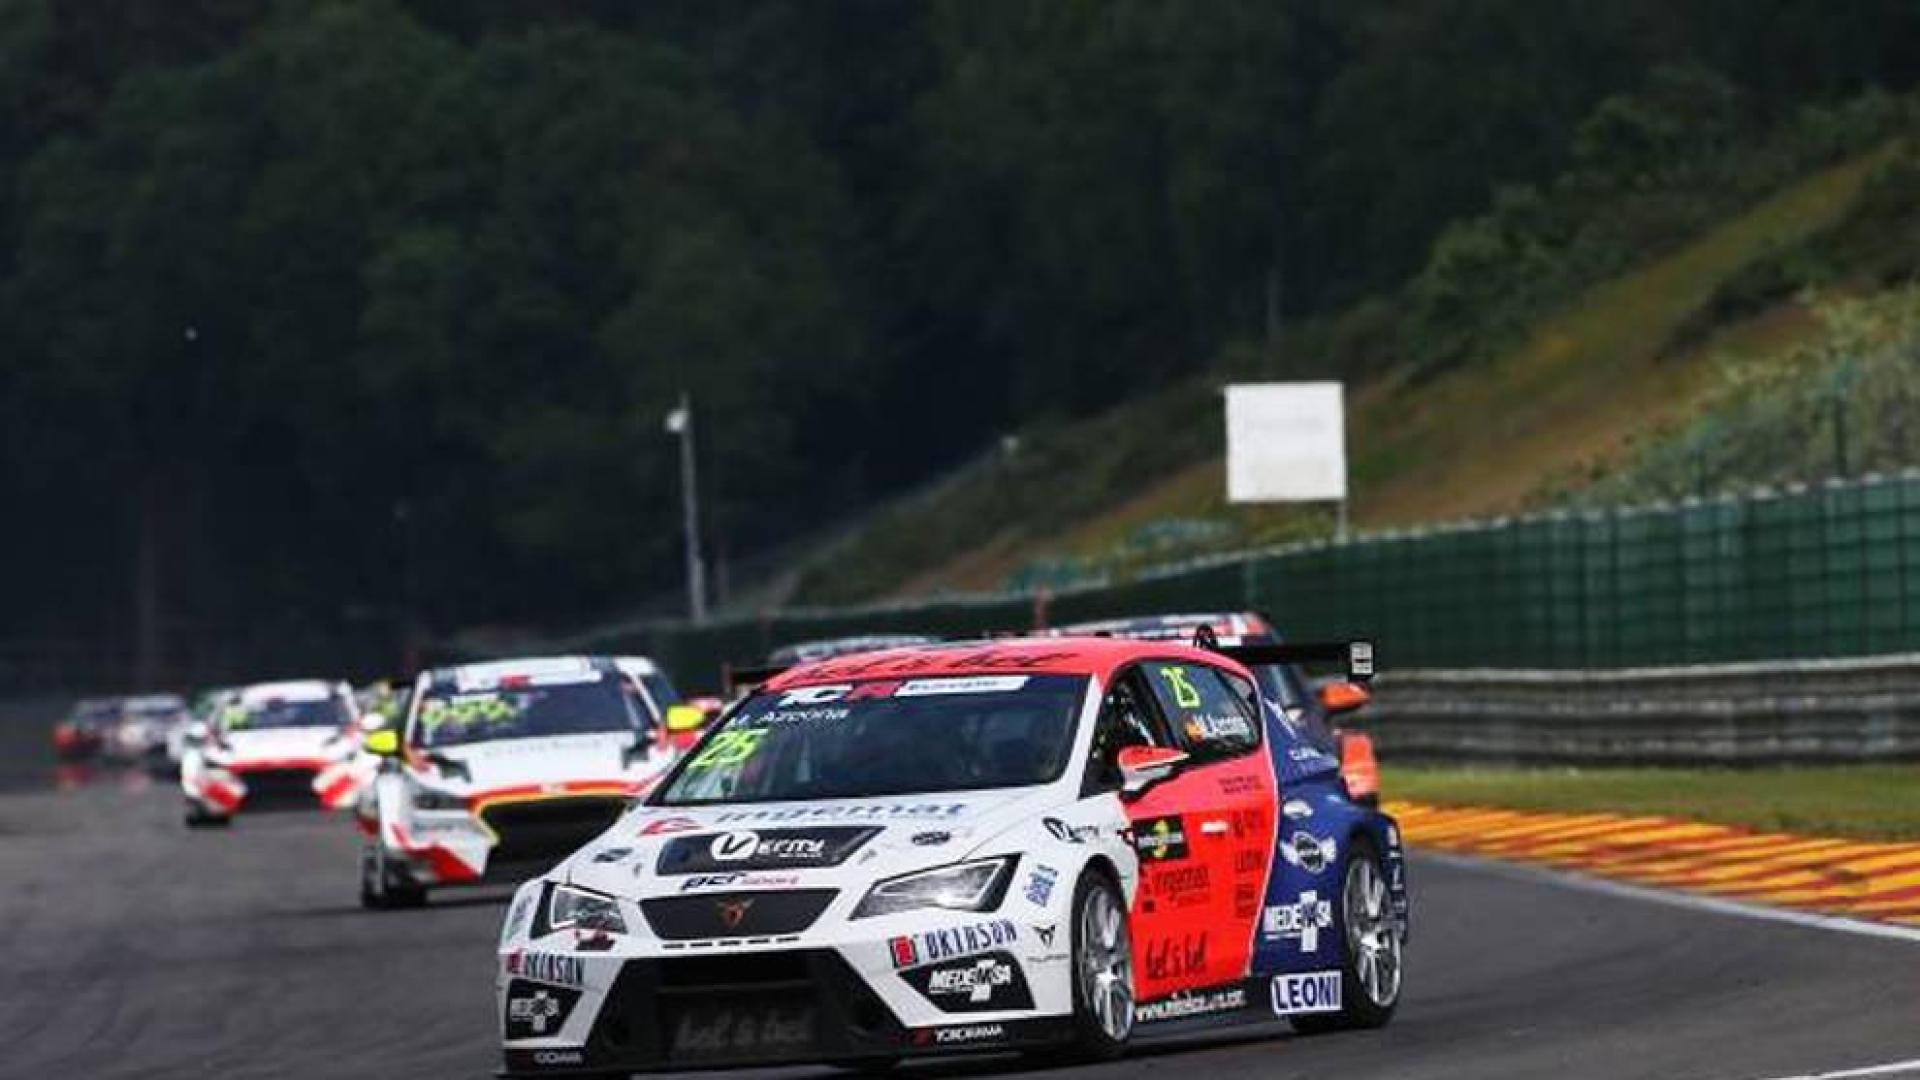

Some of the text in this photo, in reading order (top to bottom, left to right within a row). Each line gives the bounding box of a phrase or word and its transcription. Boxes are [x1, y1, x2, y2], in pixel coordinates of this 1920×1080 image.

[1160, 666, 1200, 708] 25
[687, 728, 768, 768] 25
[1275, 976, 1339, 1011] LEONI
